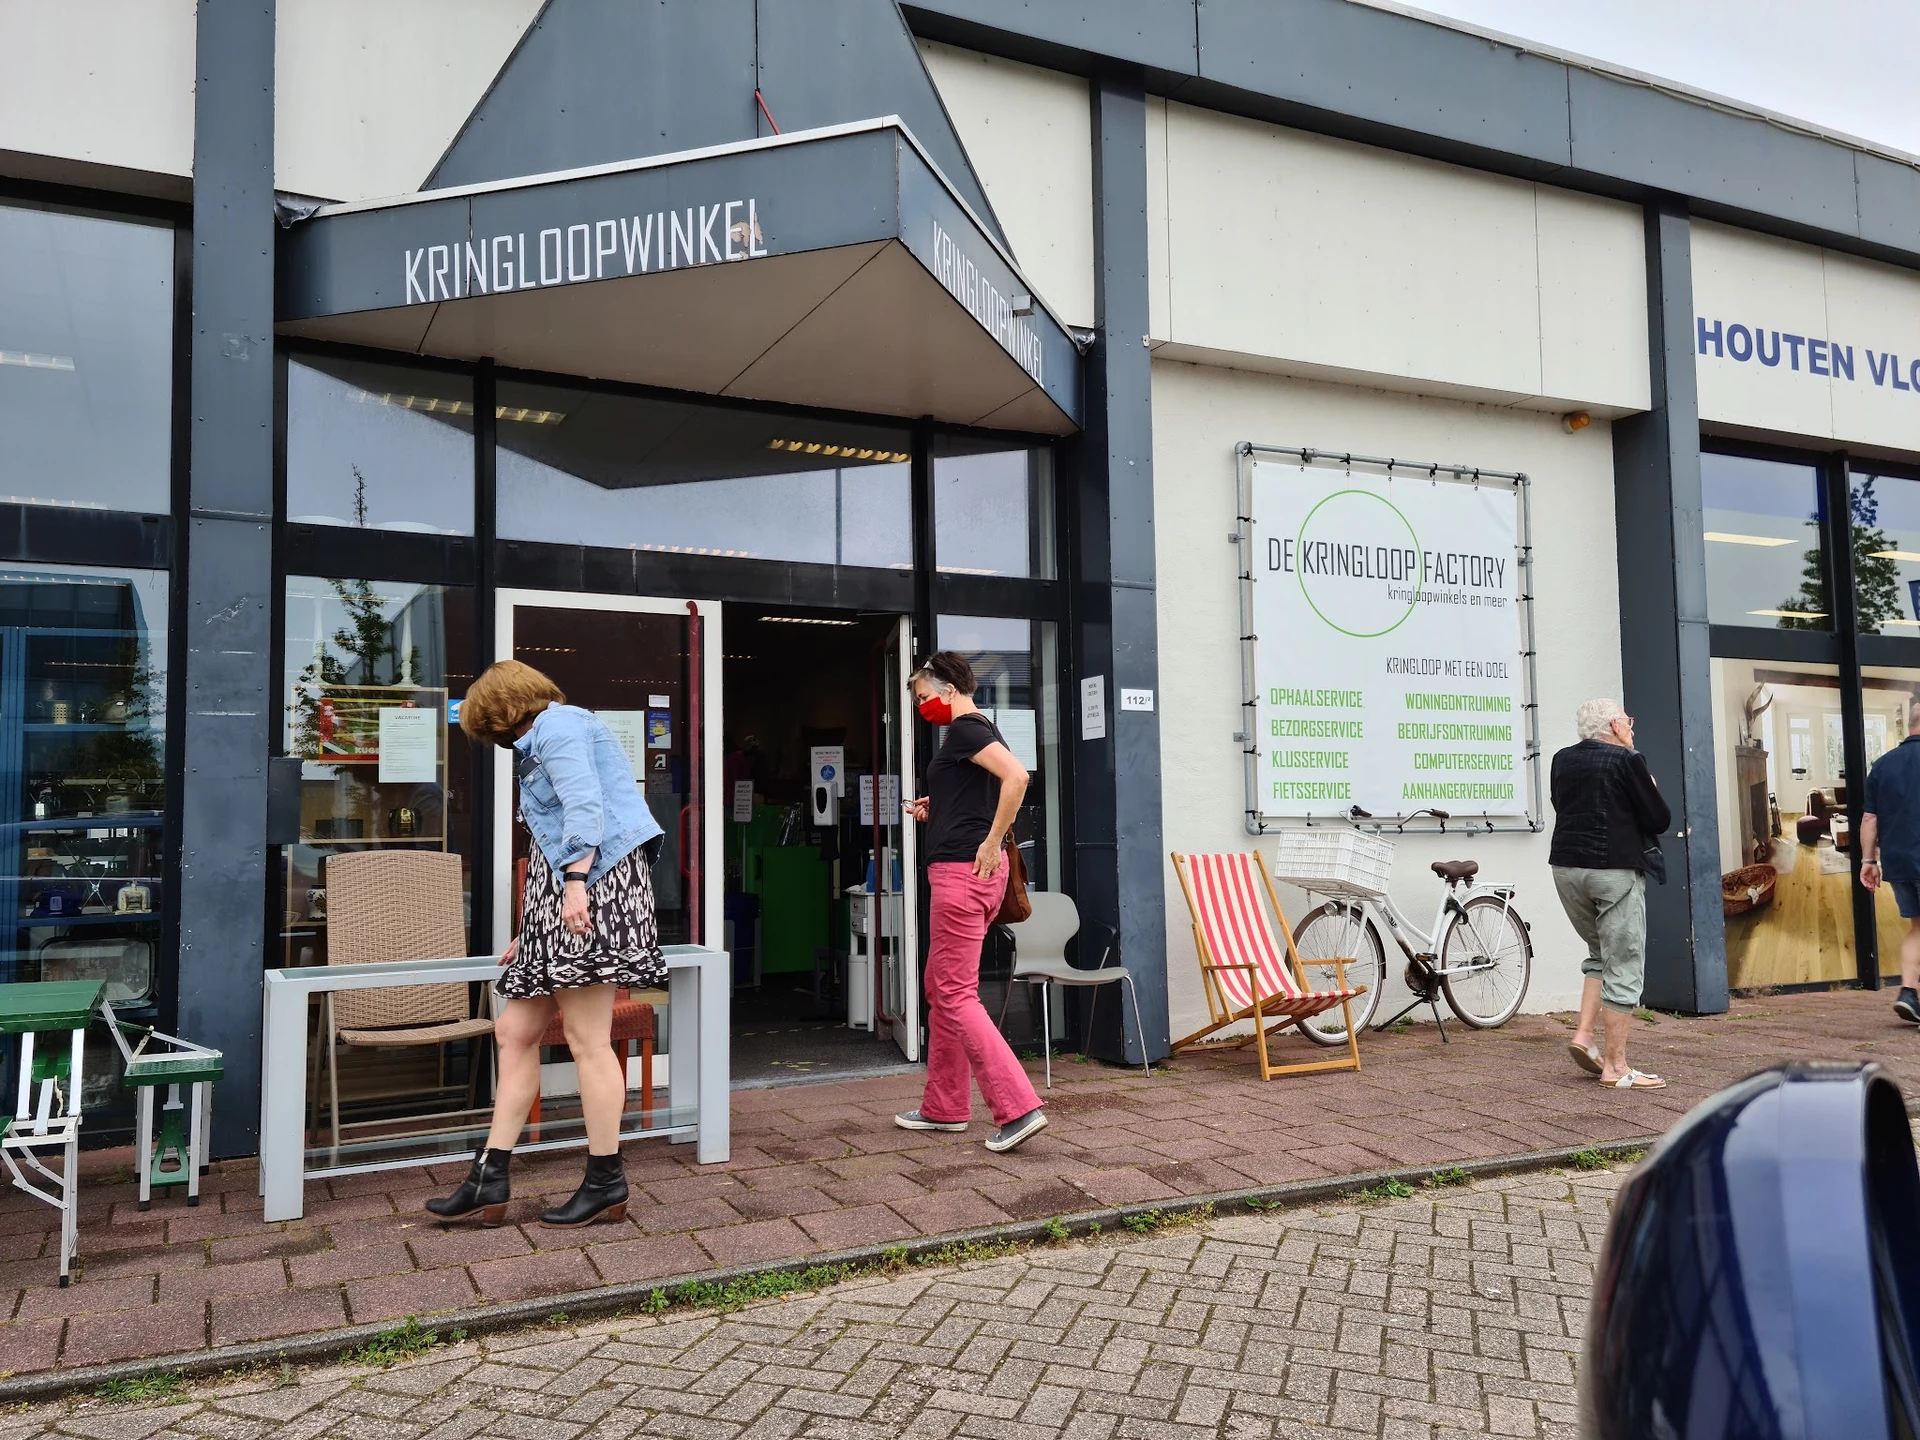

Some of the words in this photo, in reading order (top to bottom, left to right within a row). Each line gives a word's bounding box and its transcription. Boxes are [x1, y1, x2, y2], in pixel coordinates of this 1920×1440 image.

[405, 198, 768, 305] KRINGLOOPWINKEL
[933, 220, 1044, 388] KRINGLOOPWINKEL
[1697, 316, 1855, 381] HOUTEN
[1268, 537, 1294, 572] DE
[1303, 540, 1416, 582] KRINGLOOP
[1423, 551, 1506, 589] FACTORY
[1387, 584, 1468, 606] kringloopwinkels
[1470, 595, 1482, 606] en
[1484, 595, 1508, 608] meer
[1386, 657, 1442, 676] KRINGLOOP
[1445, 660, 1463, 677] MET
[1465, 661, 1483, 678] EEN
[1486, 662, 1509, 679] DOEL
[1270, 687, 1363, 708] OPHAALSERVICE
[1405, 692, 1511, 713] WONINGONTRUIMING
[1271, 719, 1364, 739] BEZORGSERVICE
[1398, 722, 1512, 742] BEDRIJFSONTRUIMING
[1271, 750, 1349, 769] KLUSSERVICE
[1414, 752, 1513, 771] COMPUTERSERVICE
[1273, 782, 1351, 800] FIETSSERVICE
[1402, 782, 1514, 800] AANHANGERVERHUUR
